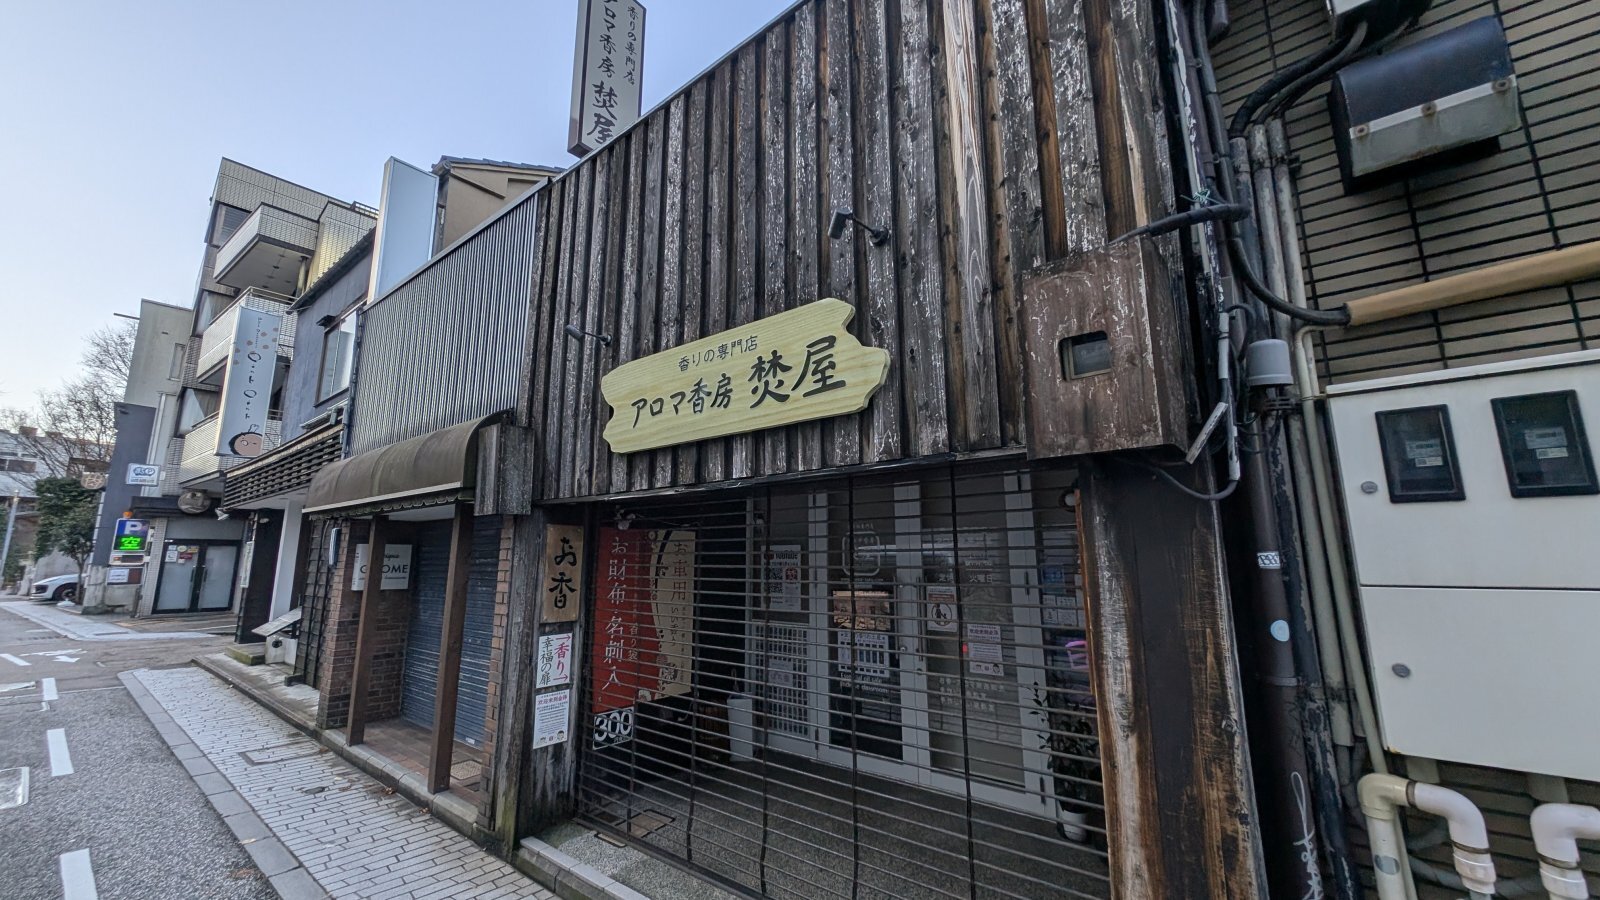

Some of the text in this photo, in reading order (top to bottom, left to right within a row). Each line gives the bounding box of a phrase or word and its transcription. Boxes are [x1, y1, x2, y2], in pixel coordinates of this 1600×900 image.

[624, 5, 639, 86] 香りの専門店
[678, 335, 759, 373] 香りの専門店
[119, 536, 142, 550] 空
[124, 521, 143, 535] P
[548, 536, 578, 610] お香
[539, 636, 555, 686] 幸福の扉
[554, 642, 570, 676] 香り
[594, 709, 633, 742] 300
